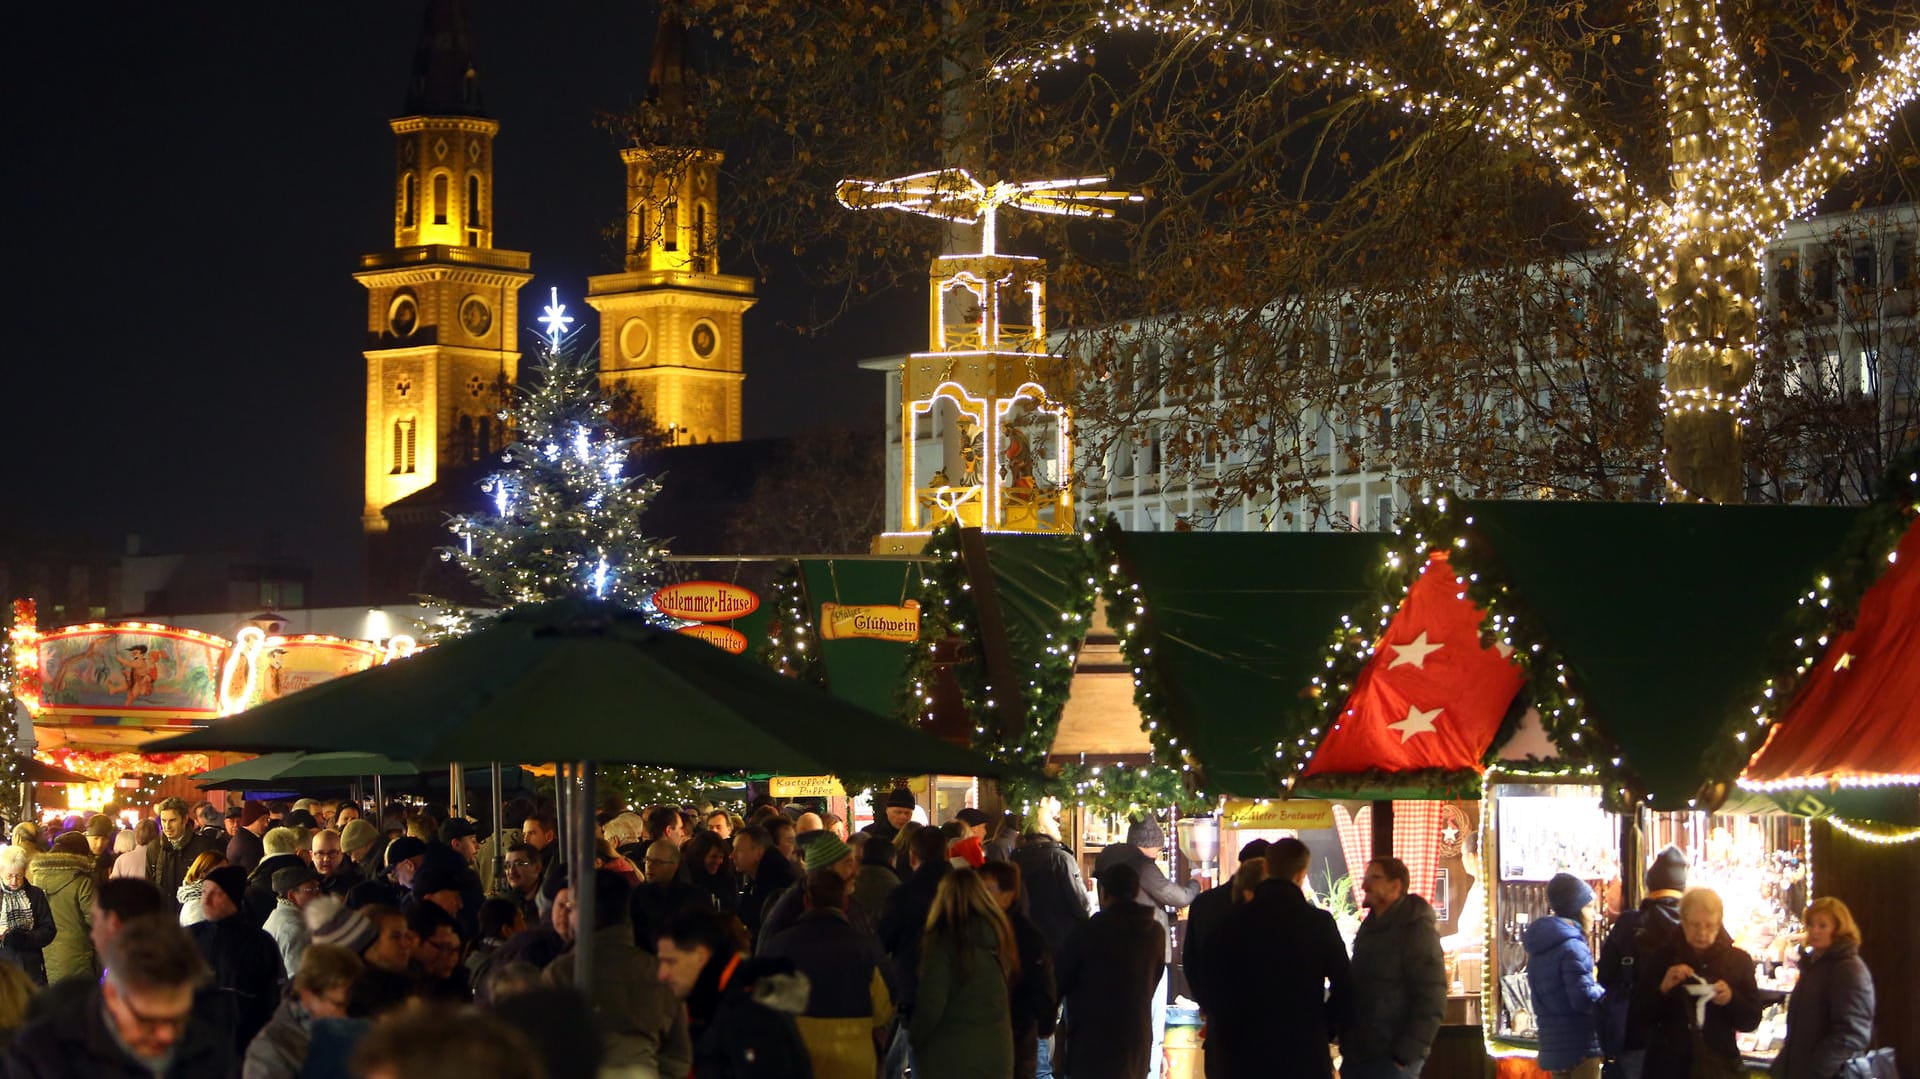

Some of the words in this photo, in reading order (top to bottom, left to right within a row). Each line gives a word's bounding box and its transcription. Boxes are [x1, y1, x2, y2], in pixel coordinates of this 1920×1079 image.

[656, 589, 753, 613] Schlemmer-Häusel
[854, 615, 916, 632] Glühwein
[1279, 810, 1326, 821] Bratwurst
